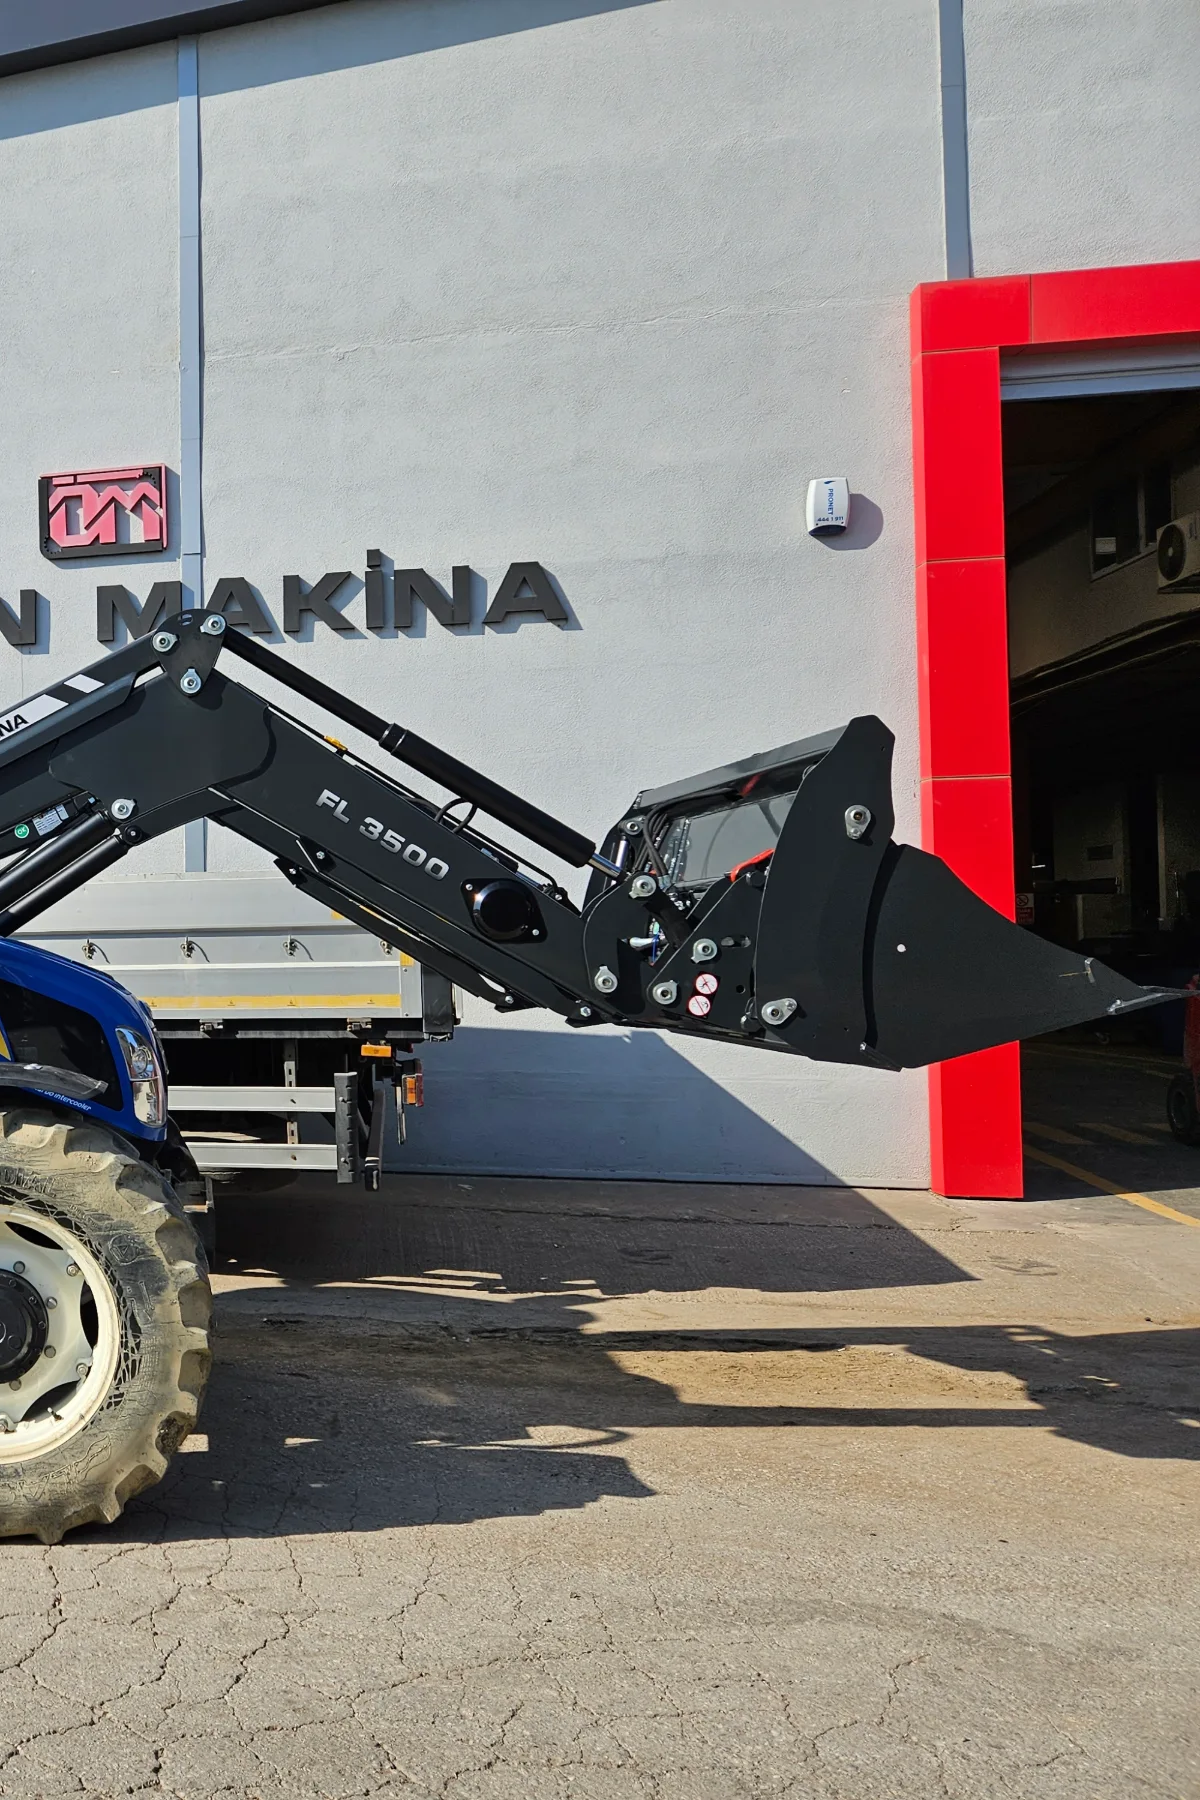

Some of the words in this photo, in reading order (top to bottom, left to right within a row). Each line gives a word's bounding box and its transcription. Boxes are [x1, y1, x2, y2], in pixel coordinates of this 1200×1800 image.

[97, 549, 568, 642] MAKİNA
[17, 826, 27, 835] OK
[315, 788, 350, 824] FL
[358, 816, 450, 881] 3500
[53, 1092, 92, 1111] intercooler
